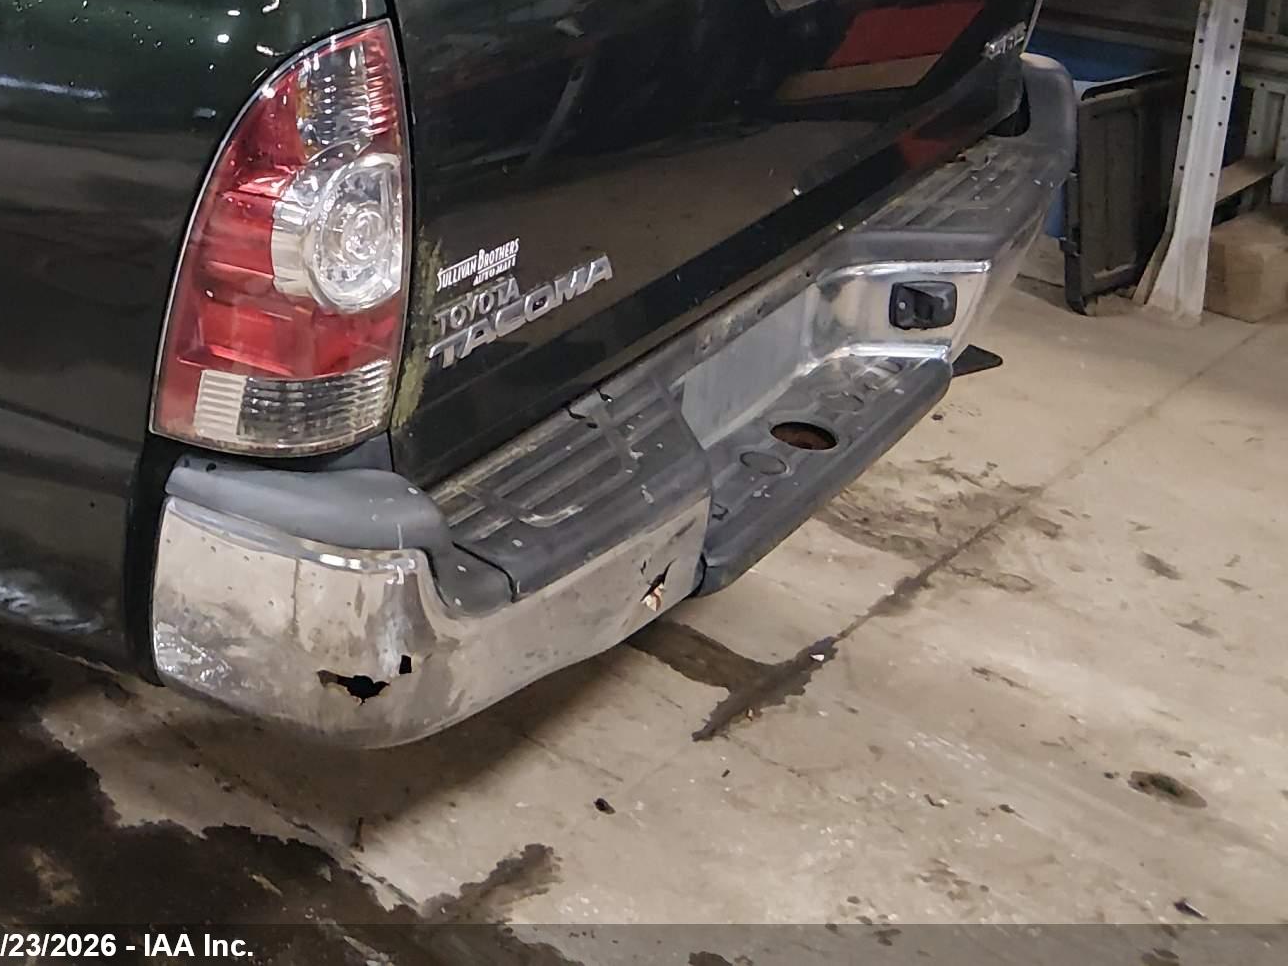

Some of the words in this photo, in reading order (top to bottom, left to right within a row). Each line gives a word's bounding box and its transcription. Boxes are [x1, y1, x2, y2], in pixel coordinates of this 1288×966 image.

[436, 257, 477, 292] SULLIVAN
[477, 237, 520, 270] BROTHERS
[428, 255, 613, 368] TACOMA
[434, 277, 520, 334] TOYOTA
